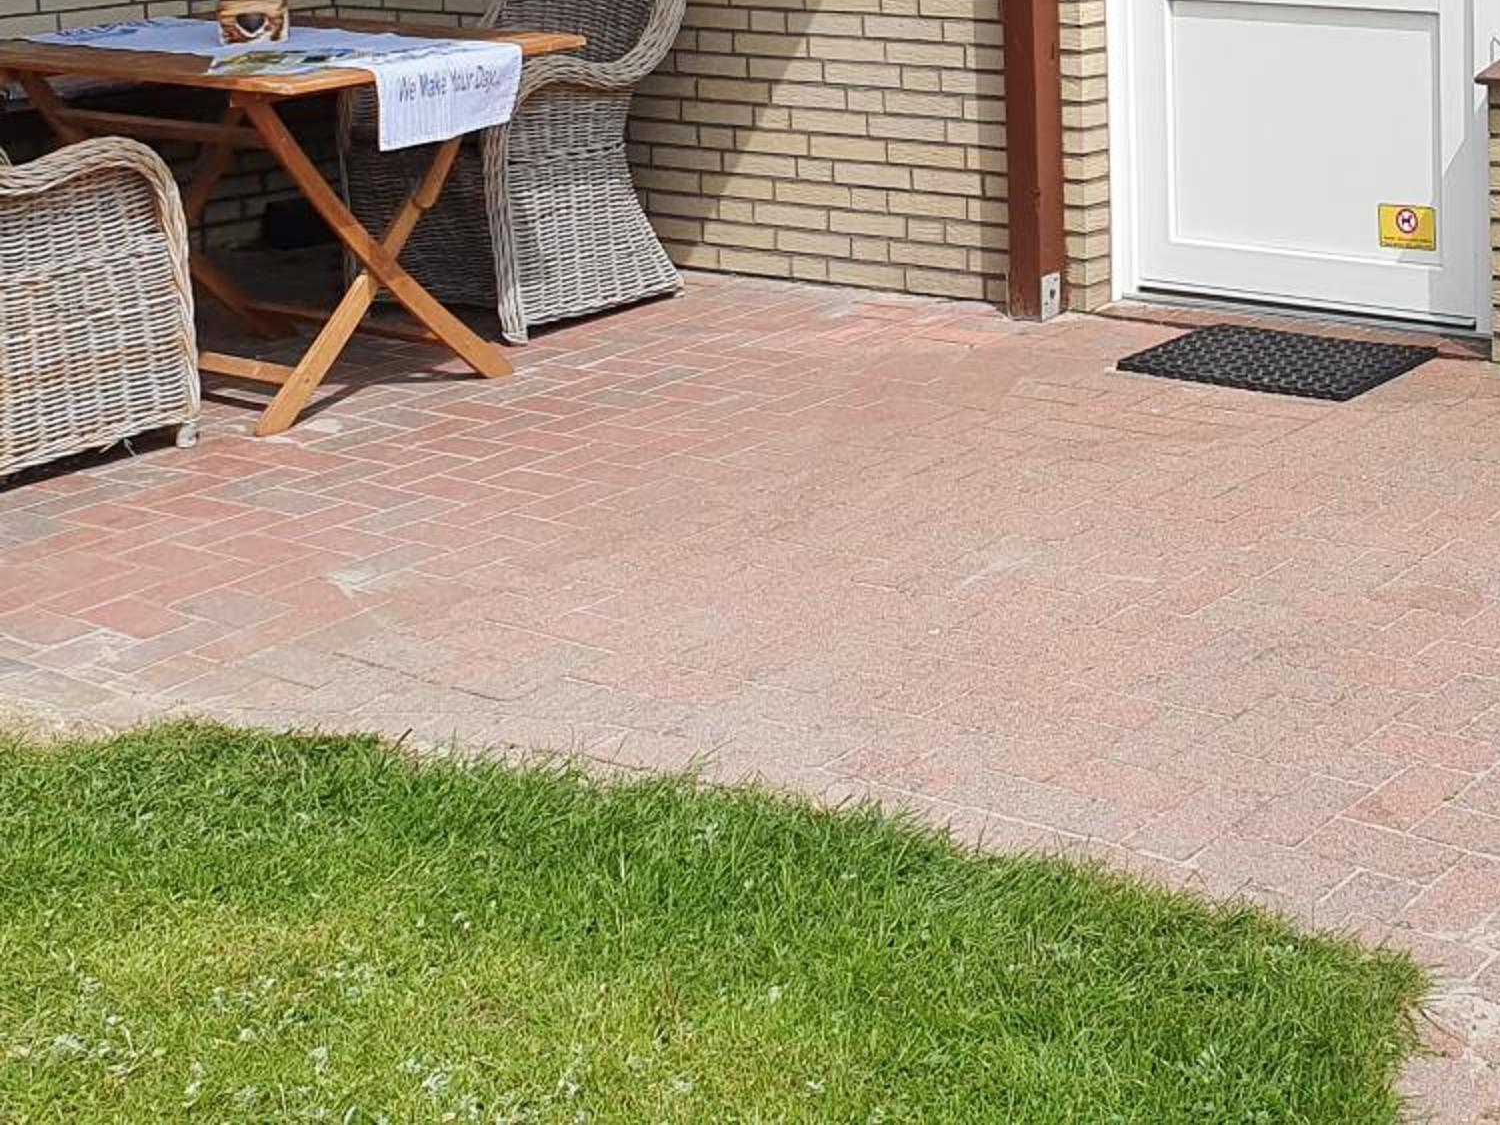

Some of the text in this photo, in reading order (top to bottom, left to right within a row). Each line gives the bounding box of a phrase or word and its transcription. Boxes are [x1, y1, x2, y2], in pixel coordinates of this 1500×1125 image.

[399, 75, 417, 103] We
[418, 71, 447, 98] Make
[449, 66, 475, 92] Your
